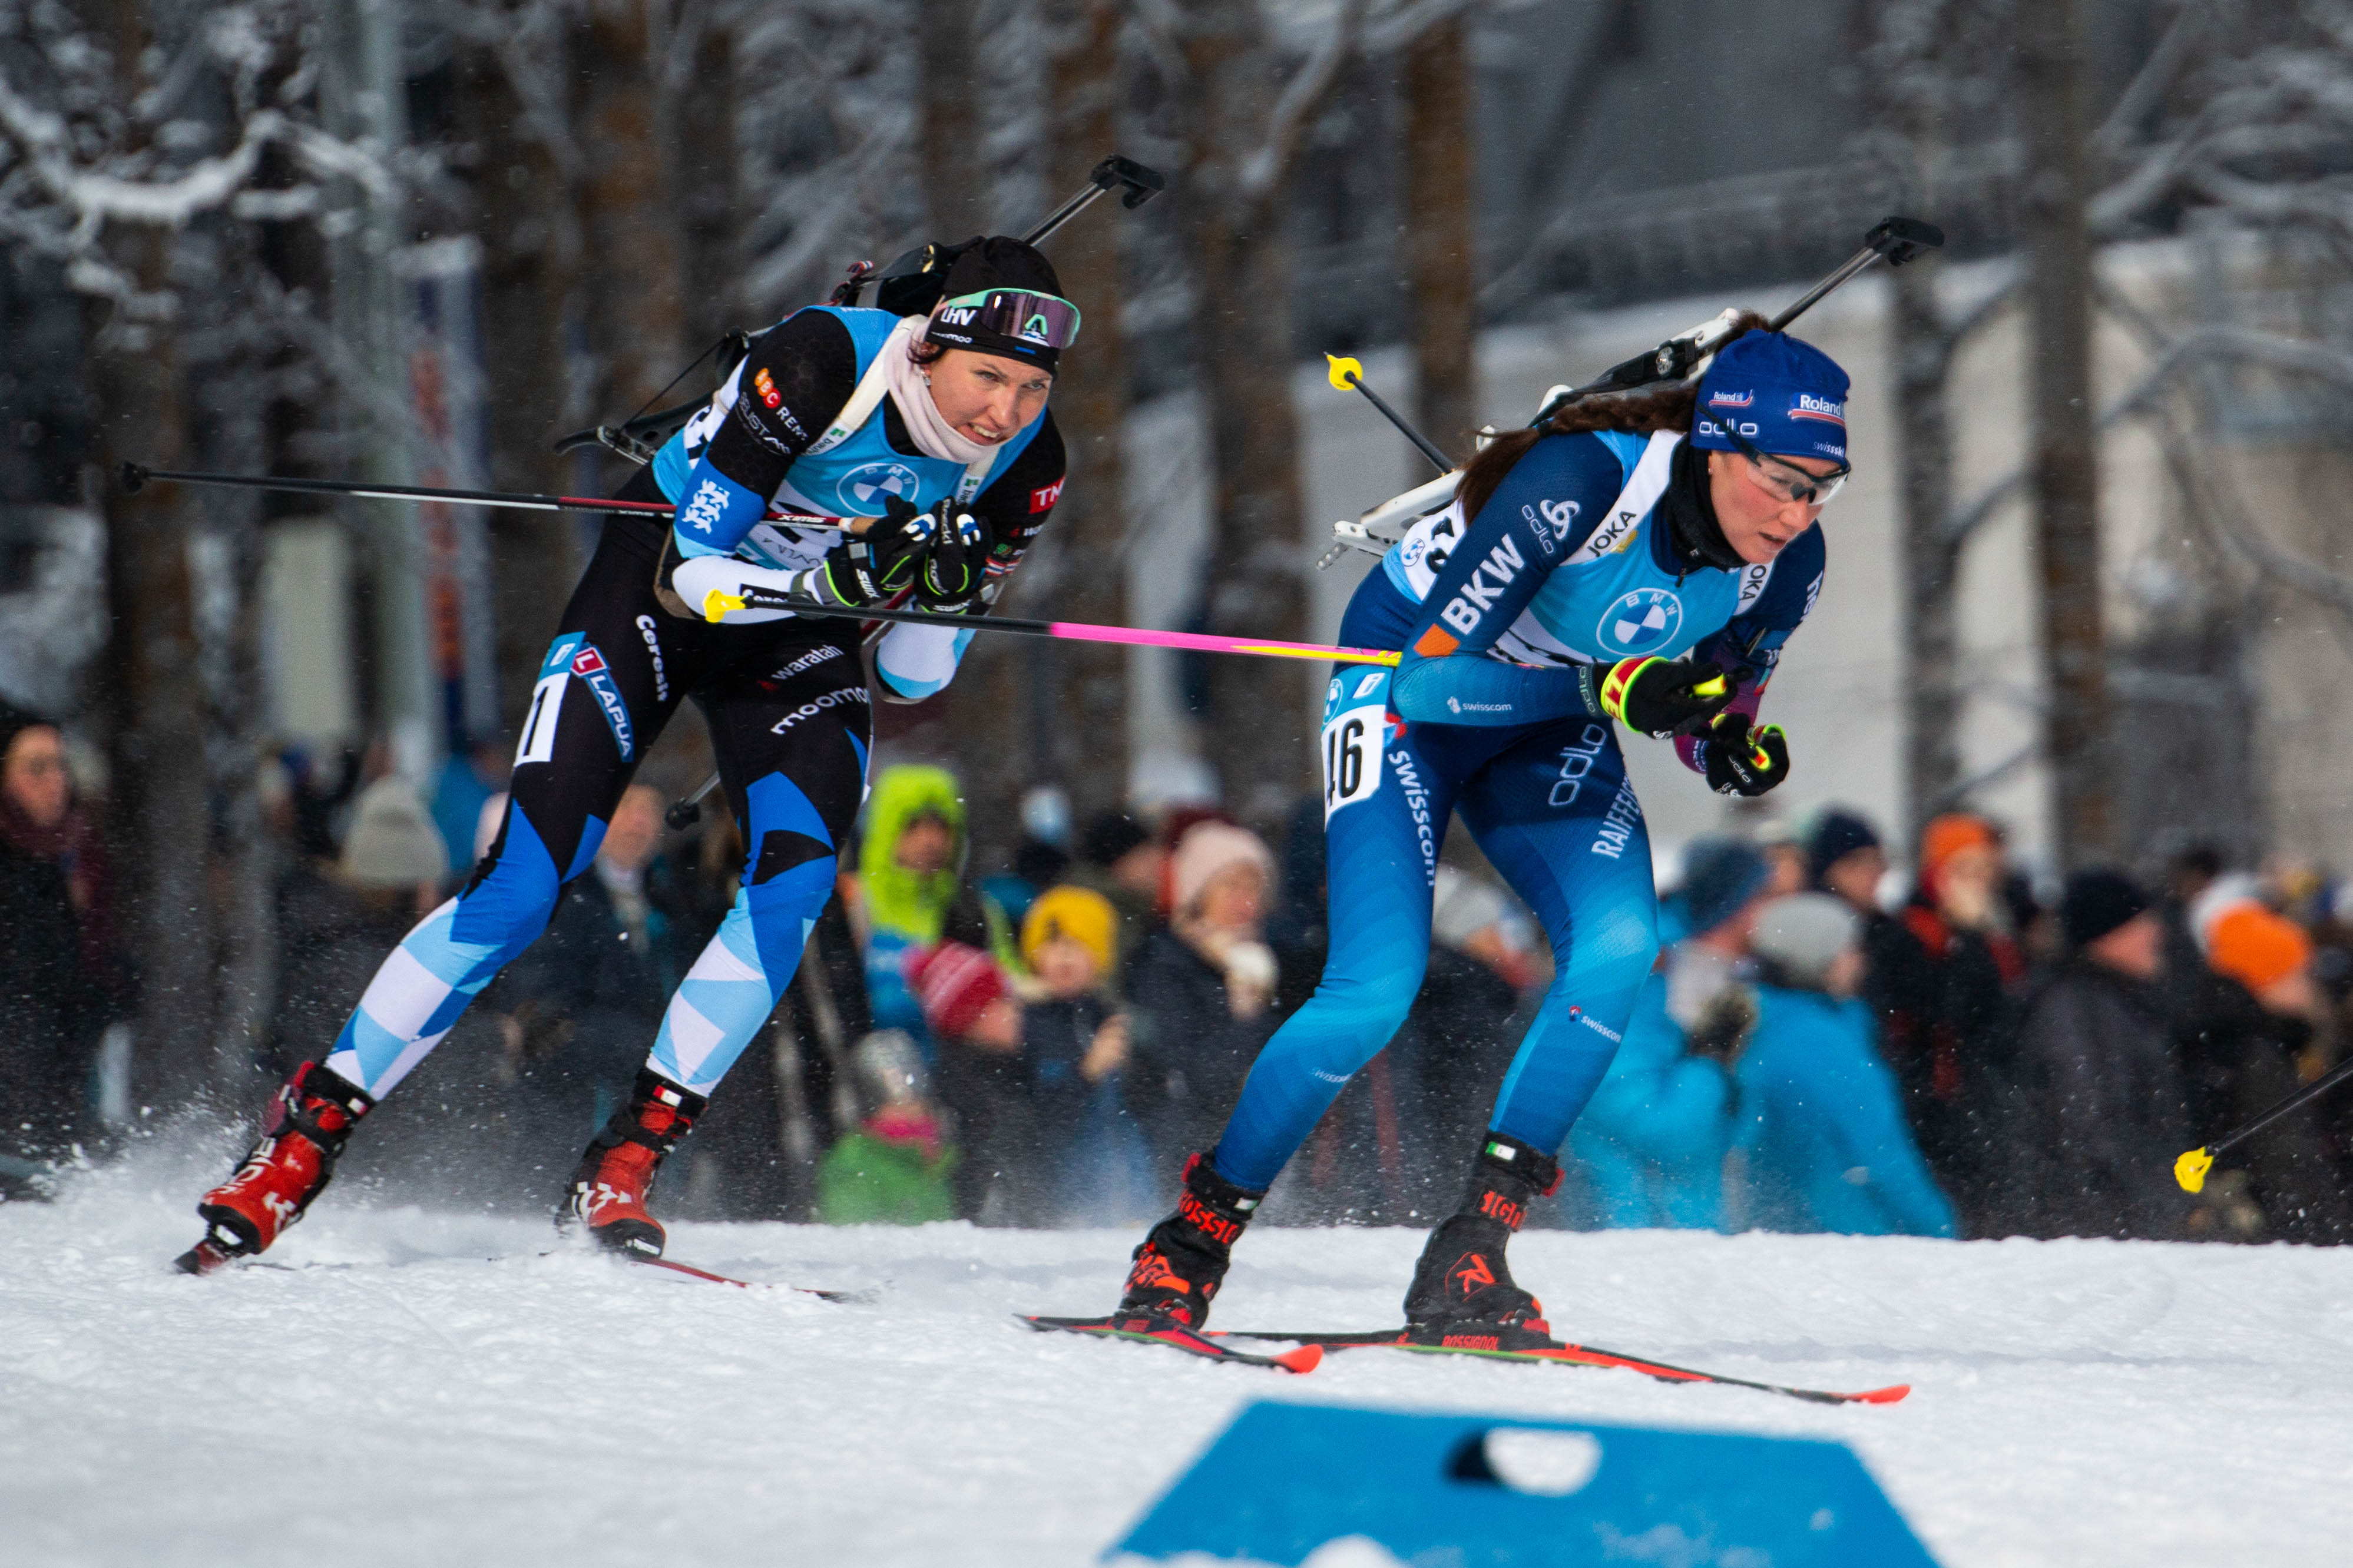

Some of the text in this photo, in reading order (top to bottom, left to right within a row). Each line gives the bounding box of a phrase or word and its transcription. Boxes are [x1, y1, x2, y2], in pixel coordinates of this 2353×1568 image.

[941, 309, 977, 326] LHV
[1714, 392, 1736, 400] Roland
[1800, 394, 1841, 416] Roland
[1521, 505, 1554, 553] odlo
[1587, 510, 1636, 557] JOKA
[855, 568, 882, 599] SWIX
[1441, 533, 1525, 635] BKW
[1738, 565, 1767, 601] OKA
[1626, 592, 1677, 616] BMW
[771, 644, 845, 680] waratah
[589, 675, 633, 757] LAPUA
[1462, 701, 1513, 711] swisscom
[1548, 723, 1607, 806] odlo
[1388, 750, 1435, 886] swisscom
[1580, 1015, 1622, 1043] swisscom
[1441, 1334, 1499, 1351] ROSSIGNOL
